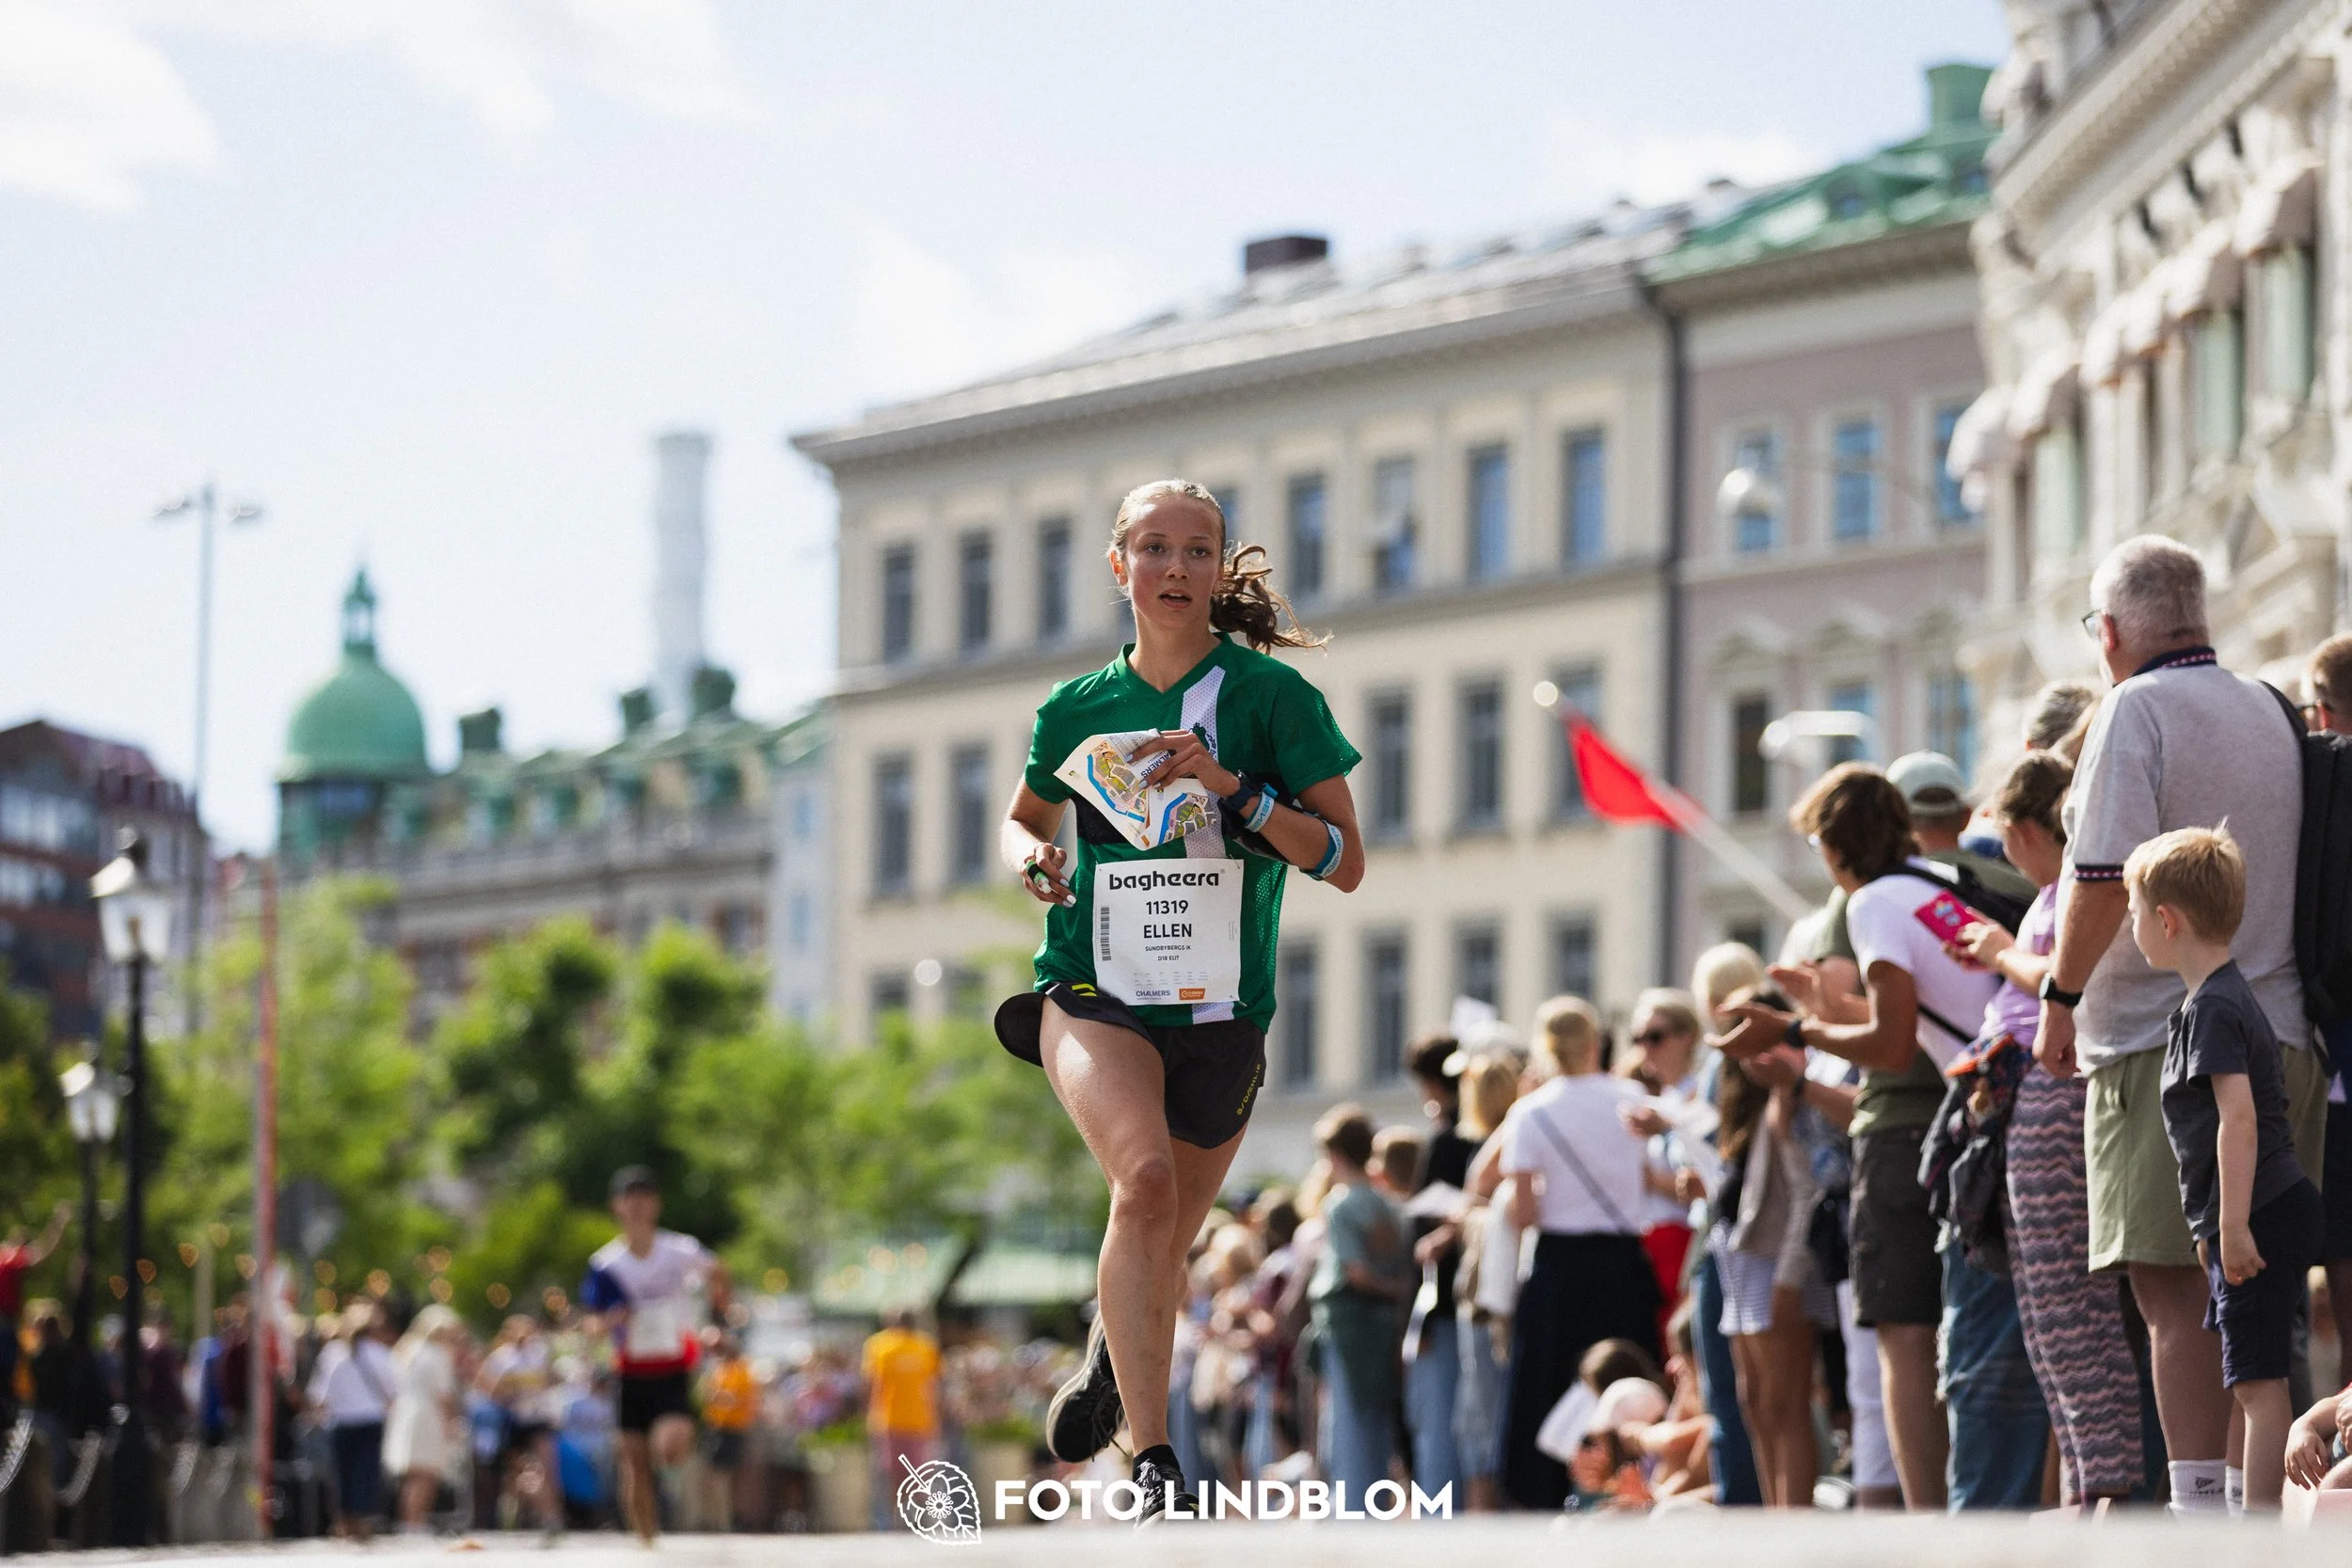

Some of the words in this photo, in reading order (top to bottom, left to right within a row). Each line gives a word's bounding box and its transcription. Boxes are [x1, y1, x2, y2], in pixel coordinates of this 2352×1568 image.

[1140, 752, 1171, 779] ALMERS
[1109, 871, 1219, 891] bagheera
[1146, 900, 1189, 915] 11319
[1143, 924, 1192, 939] ELLEN
